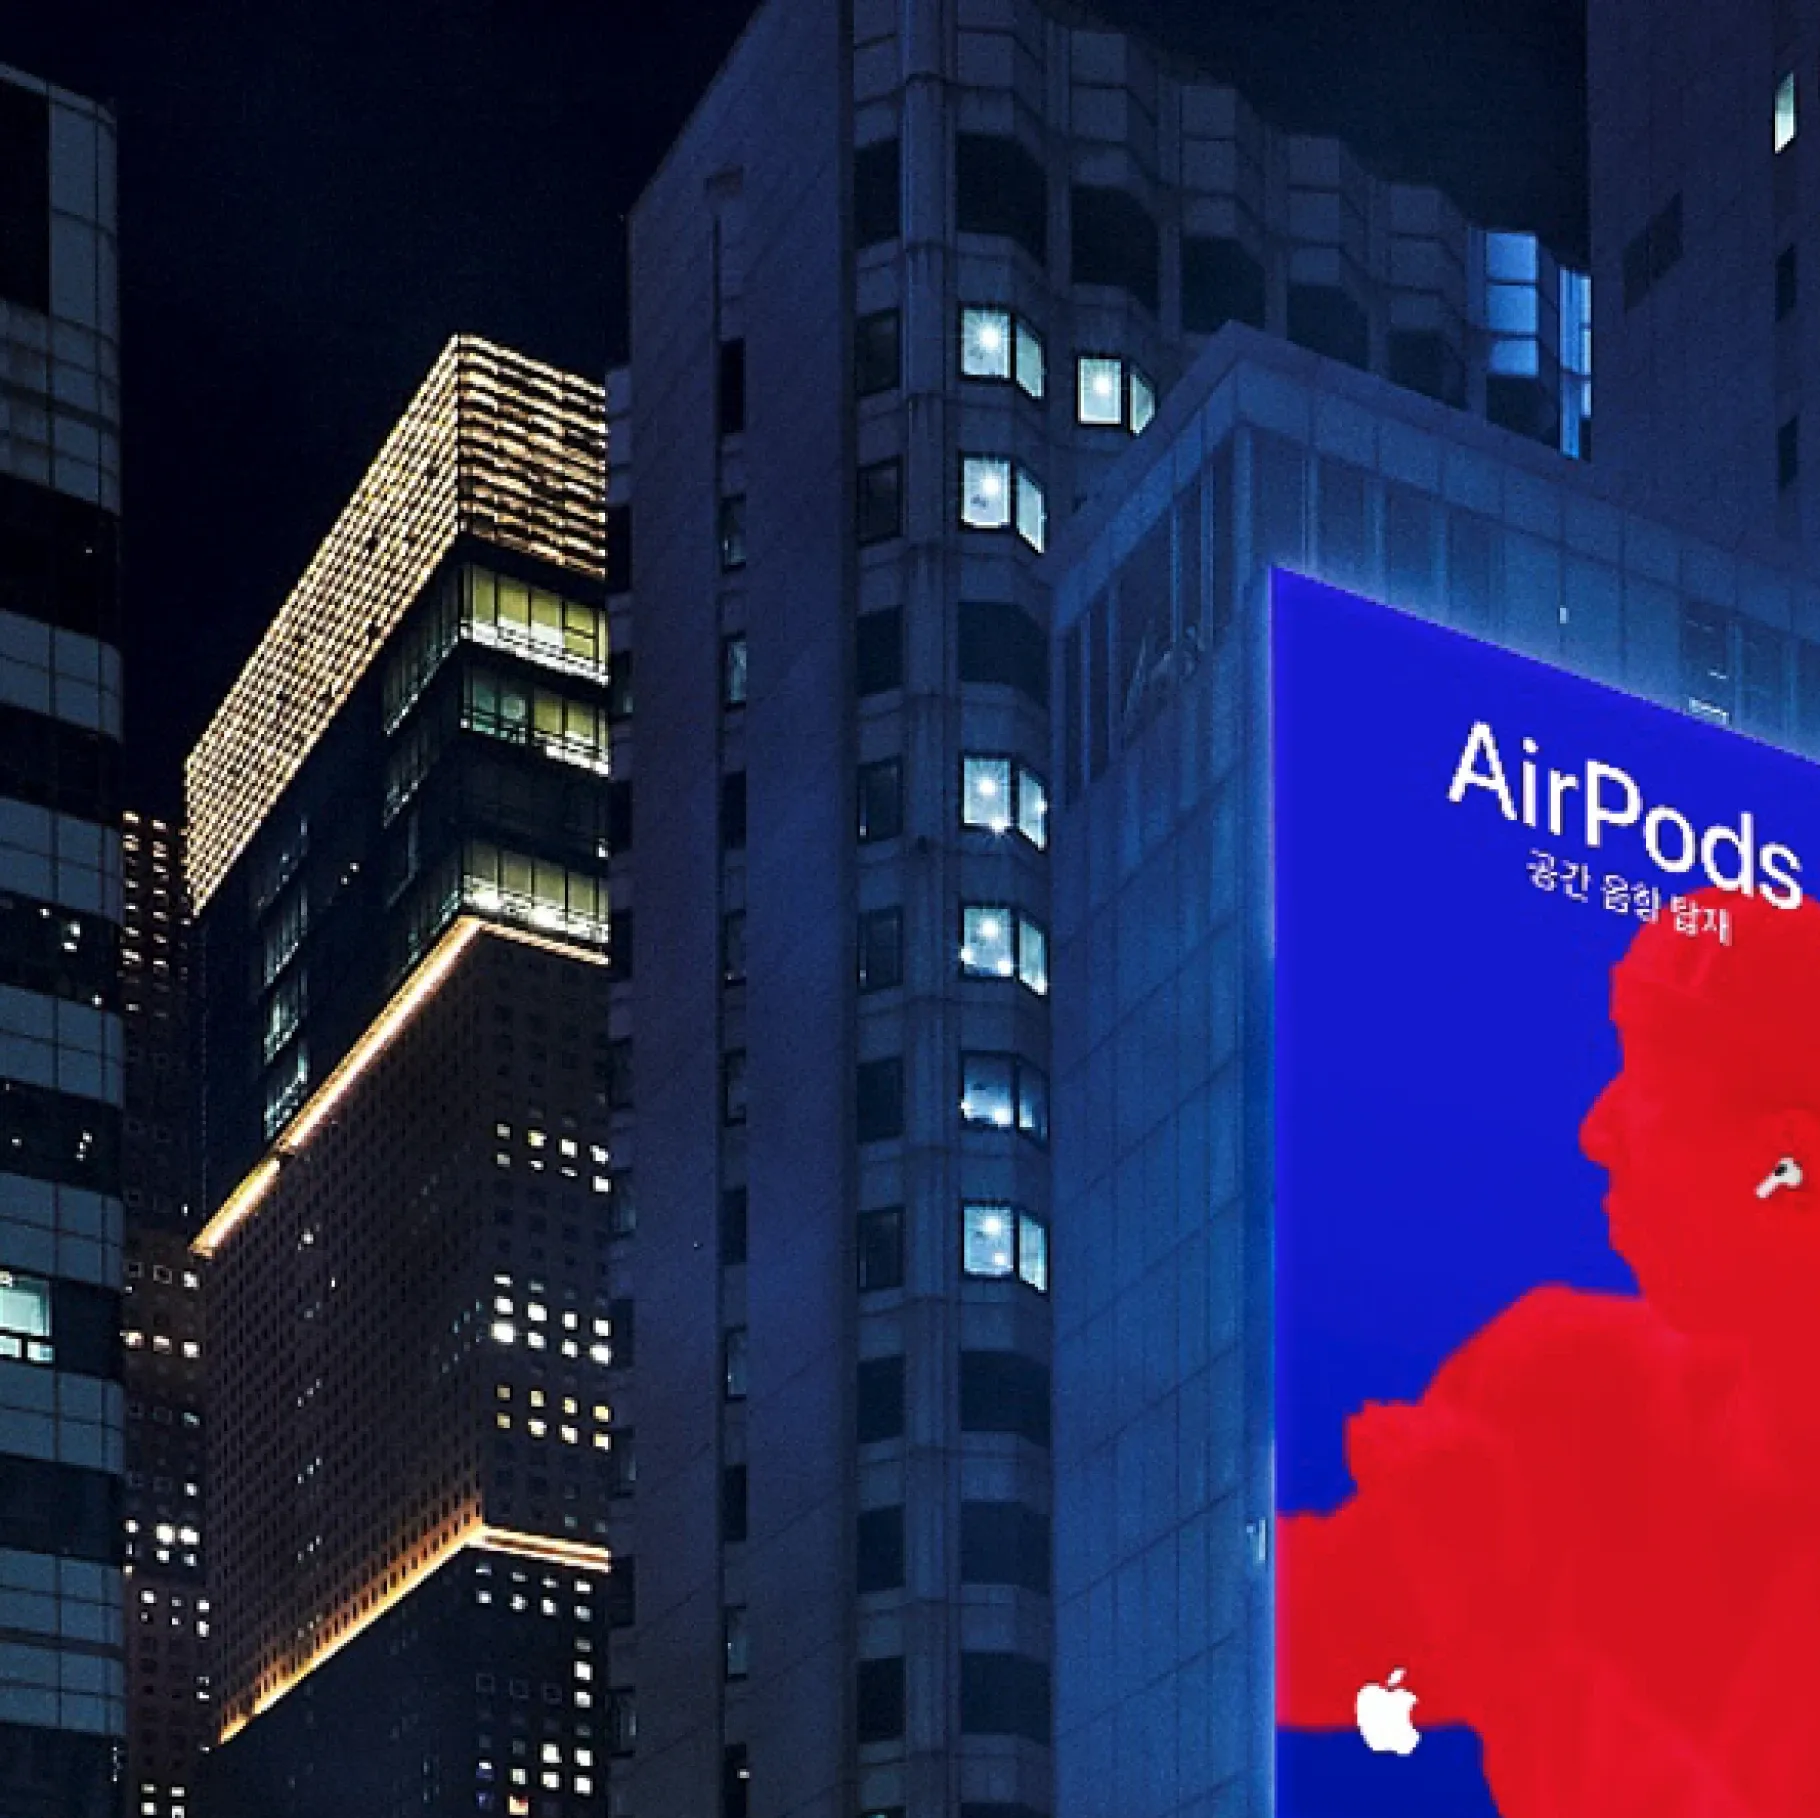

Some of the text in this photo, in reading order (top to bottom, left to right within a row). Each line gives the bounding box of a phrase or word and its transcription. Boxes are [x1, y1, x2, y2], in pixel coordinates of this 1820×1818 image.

[1447, 721, 1803, 910] AirPods
[1526, 848, 1592, 903] 공간
[1601, 874, 1660, 924] 음향
